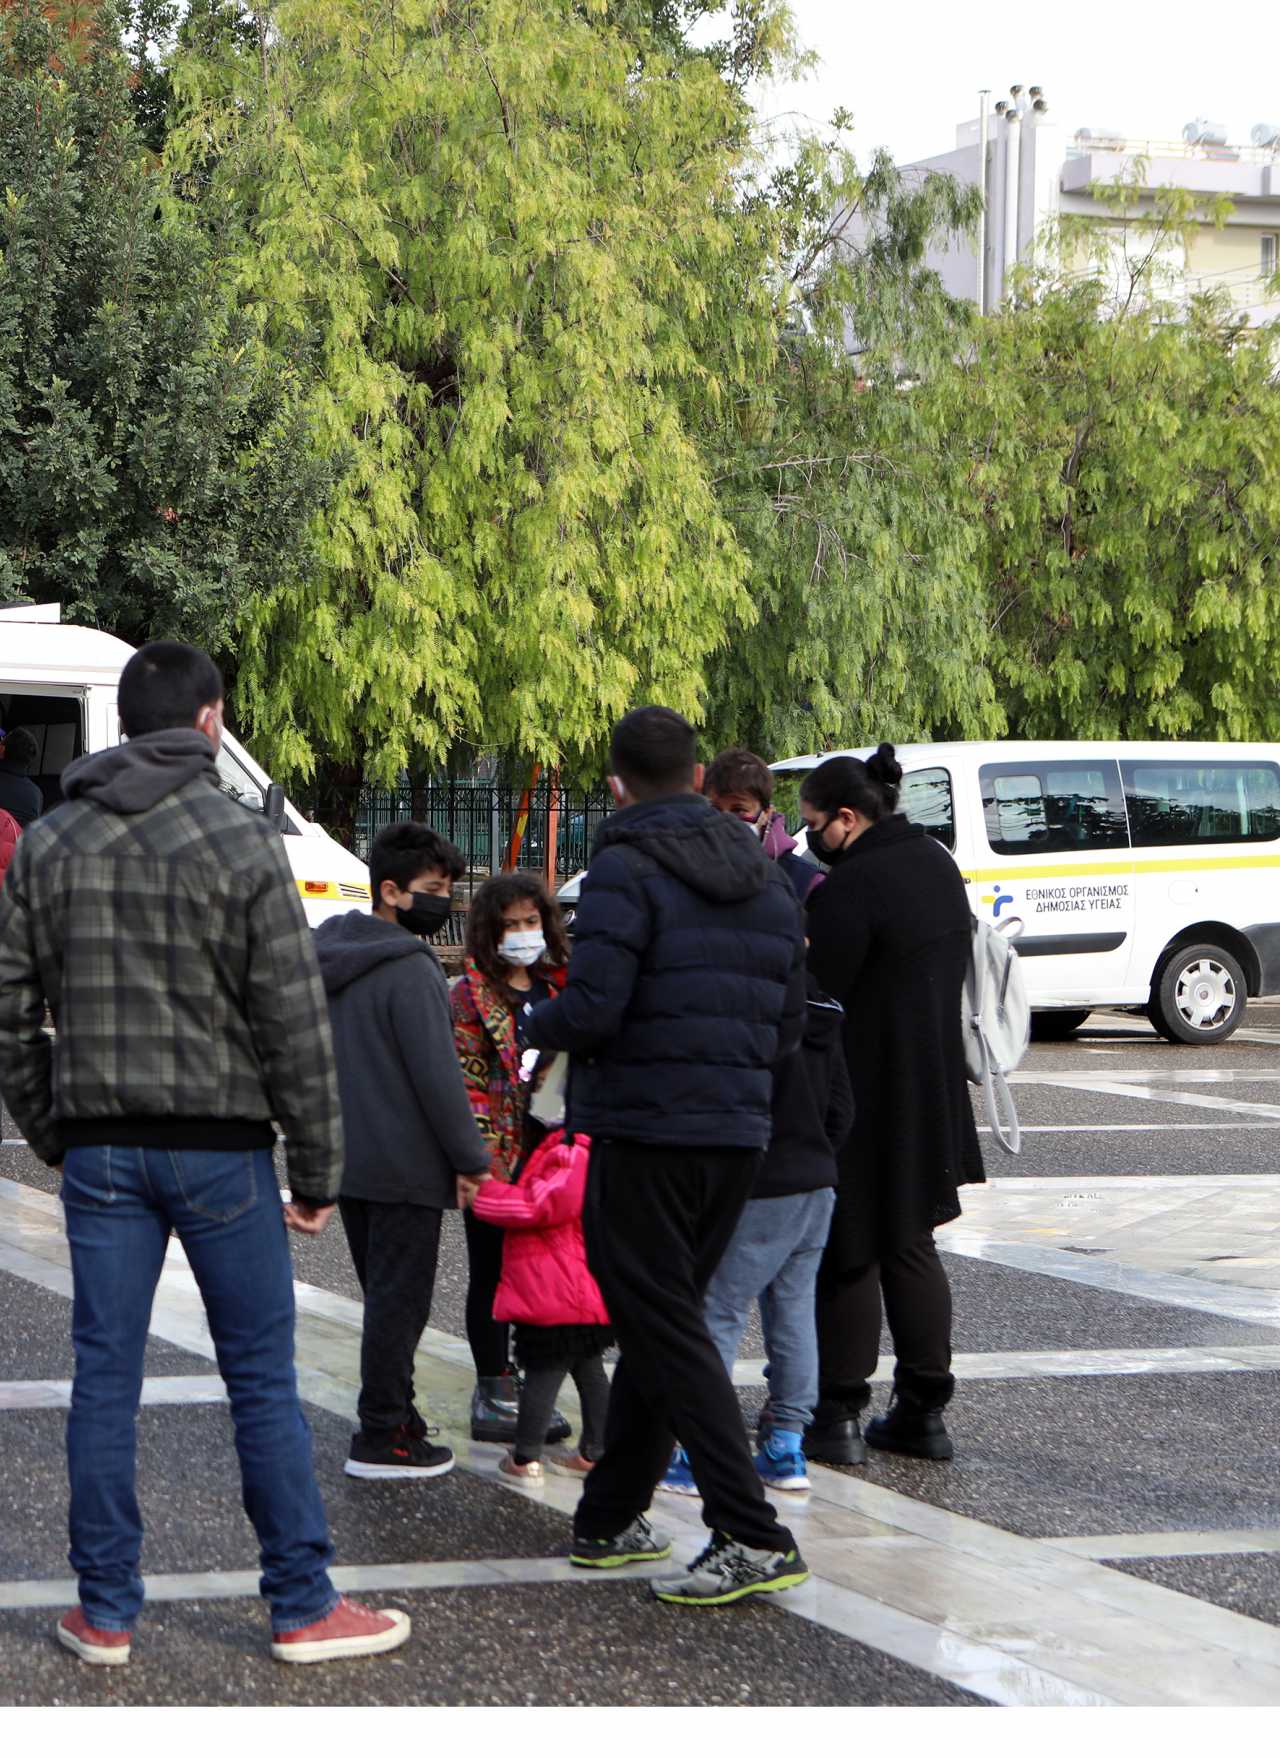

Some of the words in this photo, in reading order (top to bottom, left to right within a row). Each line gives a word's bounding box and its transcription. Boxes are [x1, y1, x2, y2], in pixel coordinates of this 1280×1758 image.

[1026, 888, 1067, 900] ΕΘΝΙΚΟΣ
[1069, 884, 1129, 898] ΟΡΓΑΝΙΣΜΟΣ
[1036, 900, 1086, 913] ΔΗΜΟΣΙΑΣ
[1089, 898, 1122, 911] ΥΓΕΙΑΣ
